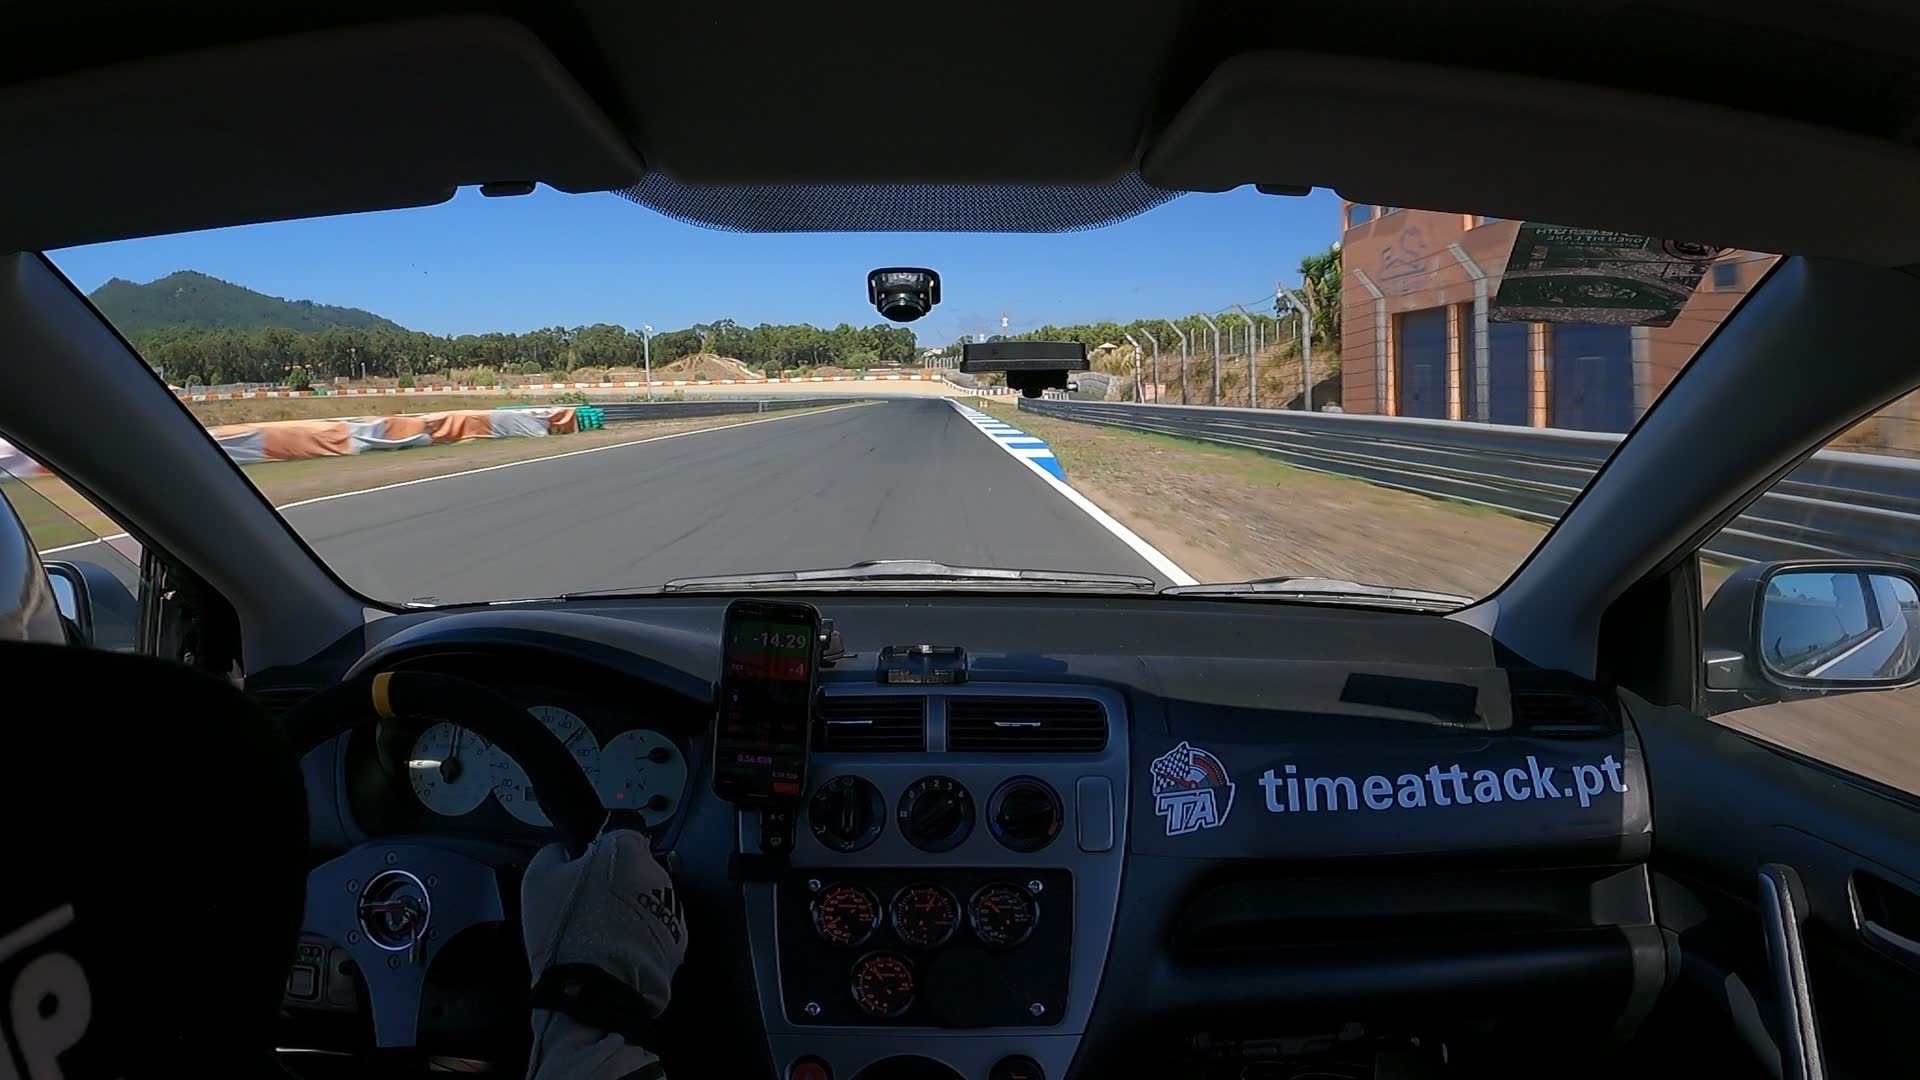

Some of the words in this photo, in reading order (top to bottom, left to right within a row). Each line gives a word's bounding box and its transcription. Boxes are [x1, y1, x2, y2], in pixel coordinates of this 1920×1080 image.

[752, 631, 806, 649] -14.29
[932, 778, 940, 788] 2
[946, 781, 953, 791] 3
[957, 789, 964, 799] 4
[1258, 754, 1629, 808] timeattack.pt
[1158, 795, 1217, 834] TA
[637, 893, 681, 945] adidas
